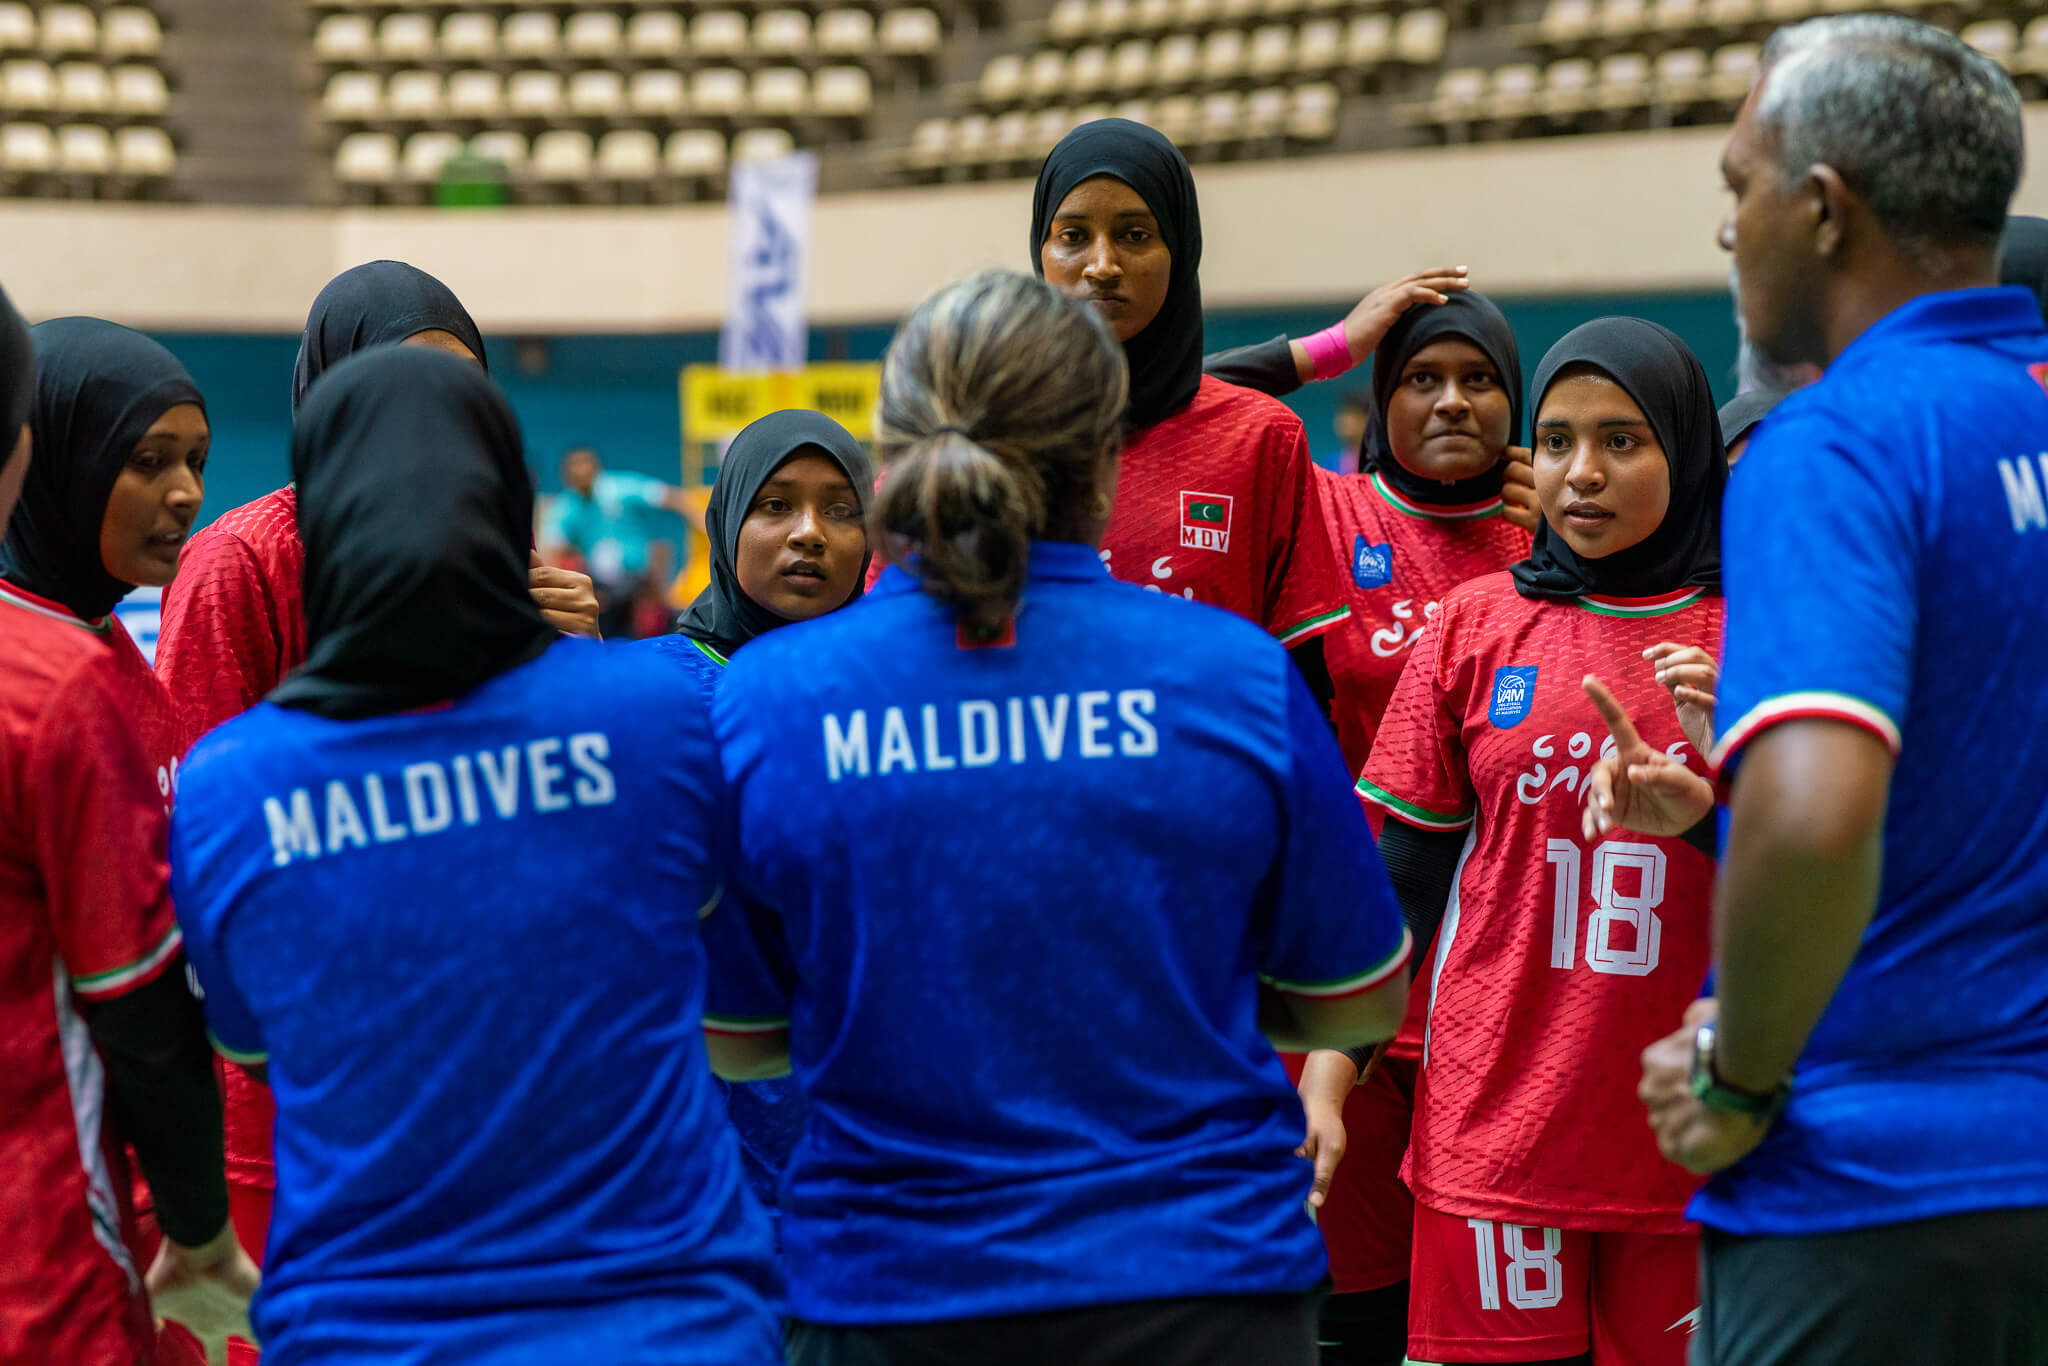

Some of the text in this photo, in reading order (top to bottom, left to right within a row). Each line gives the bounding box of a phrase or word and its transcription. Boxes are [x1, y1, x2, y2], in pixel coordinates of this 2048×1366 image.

[1182, 528, 1227, 550] MDV
[823, 689, 1159, 783] MALDIVES
[1497, 688, 1525, 703] VAM
[264, 732, 616, 867] MALDIVES
[1546, 838, 1667, 976] 18
[1468, 1218, 1563, 1310] 18
